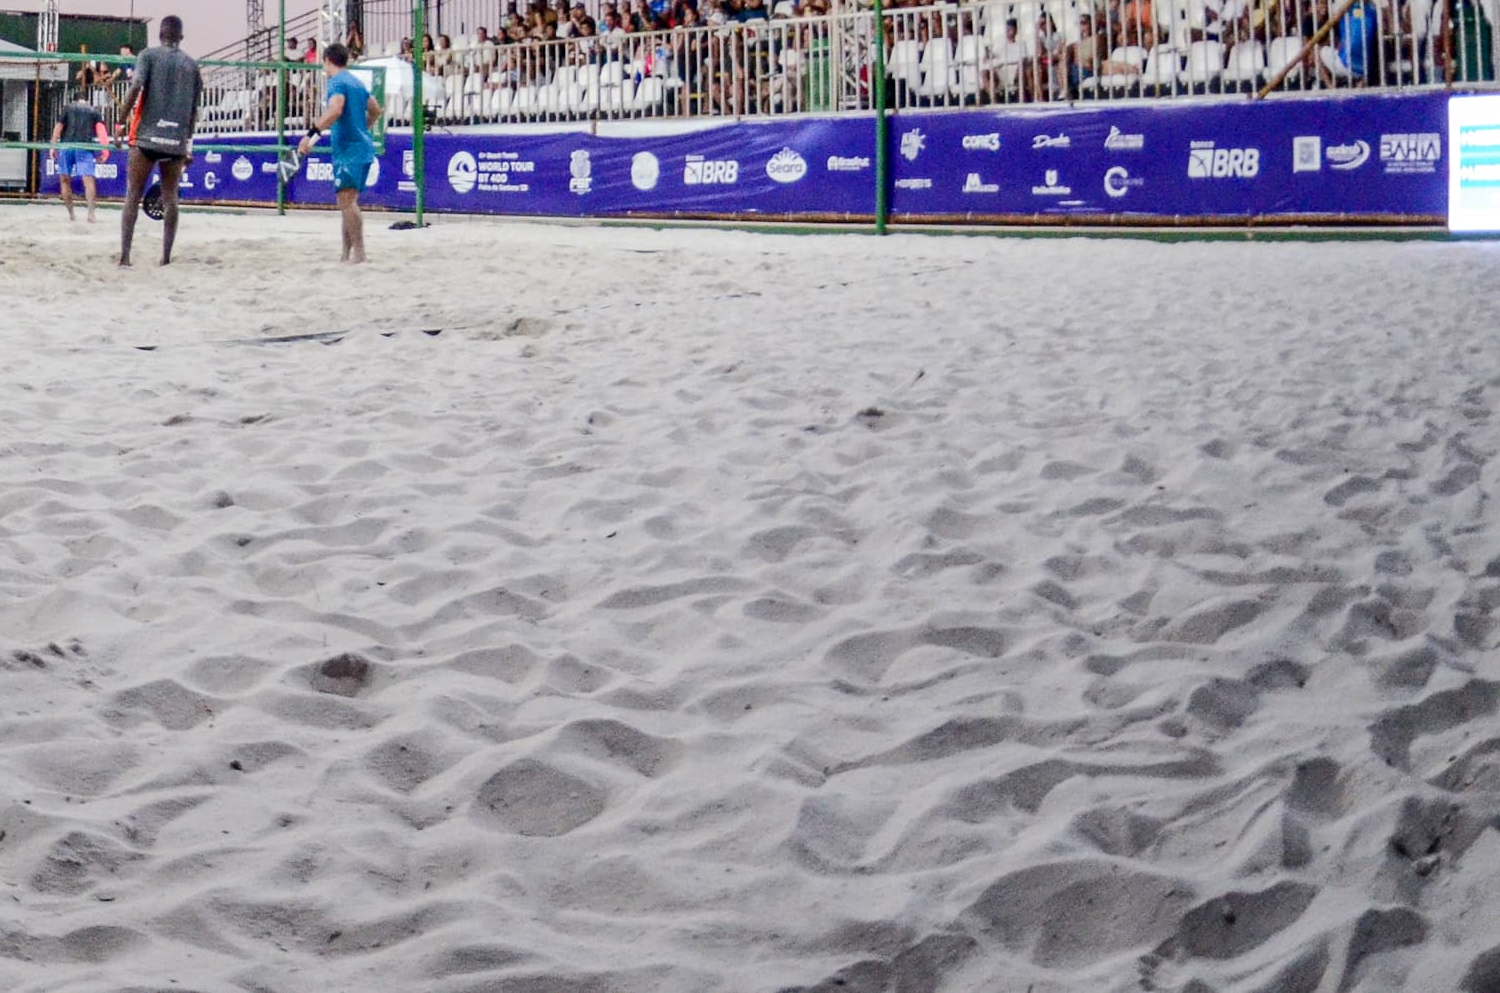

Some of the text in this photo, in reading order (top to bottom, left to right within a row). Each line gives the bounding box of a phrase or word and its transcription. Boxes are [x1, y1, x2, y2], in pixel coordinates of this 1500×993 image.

[510, 161, 535, 173] TOUR
[702, 160, 739, 184] BRB
[768, 162, 802, 174] Seara
[1212, 148, 1261, 179] BRB
